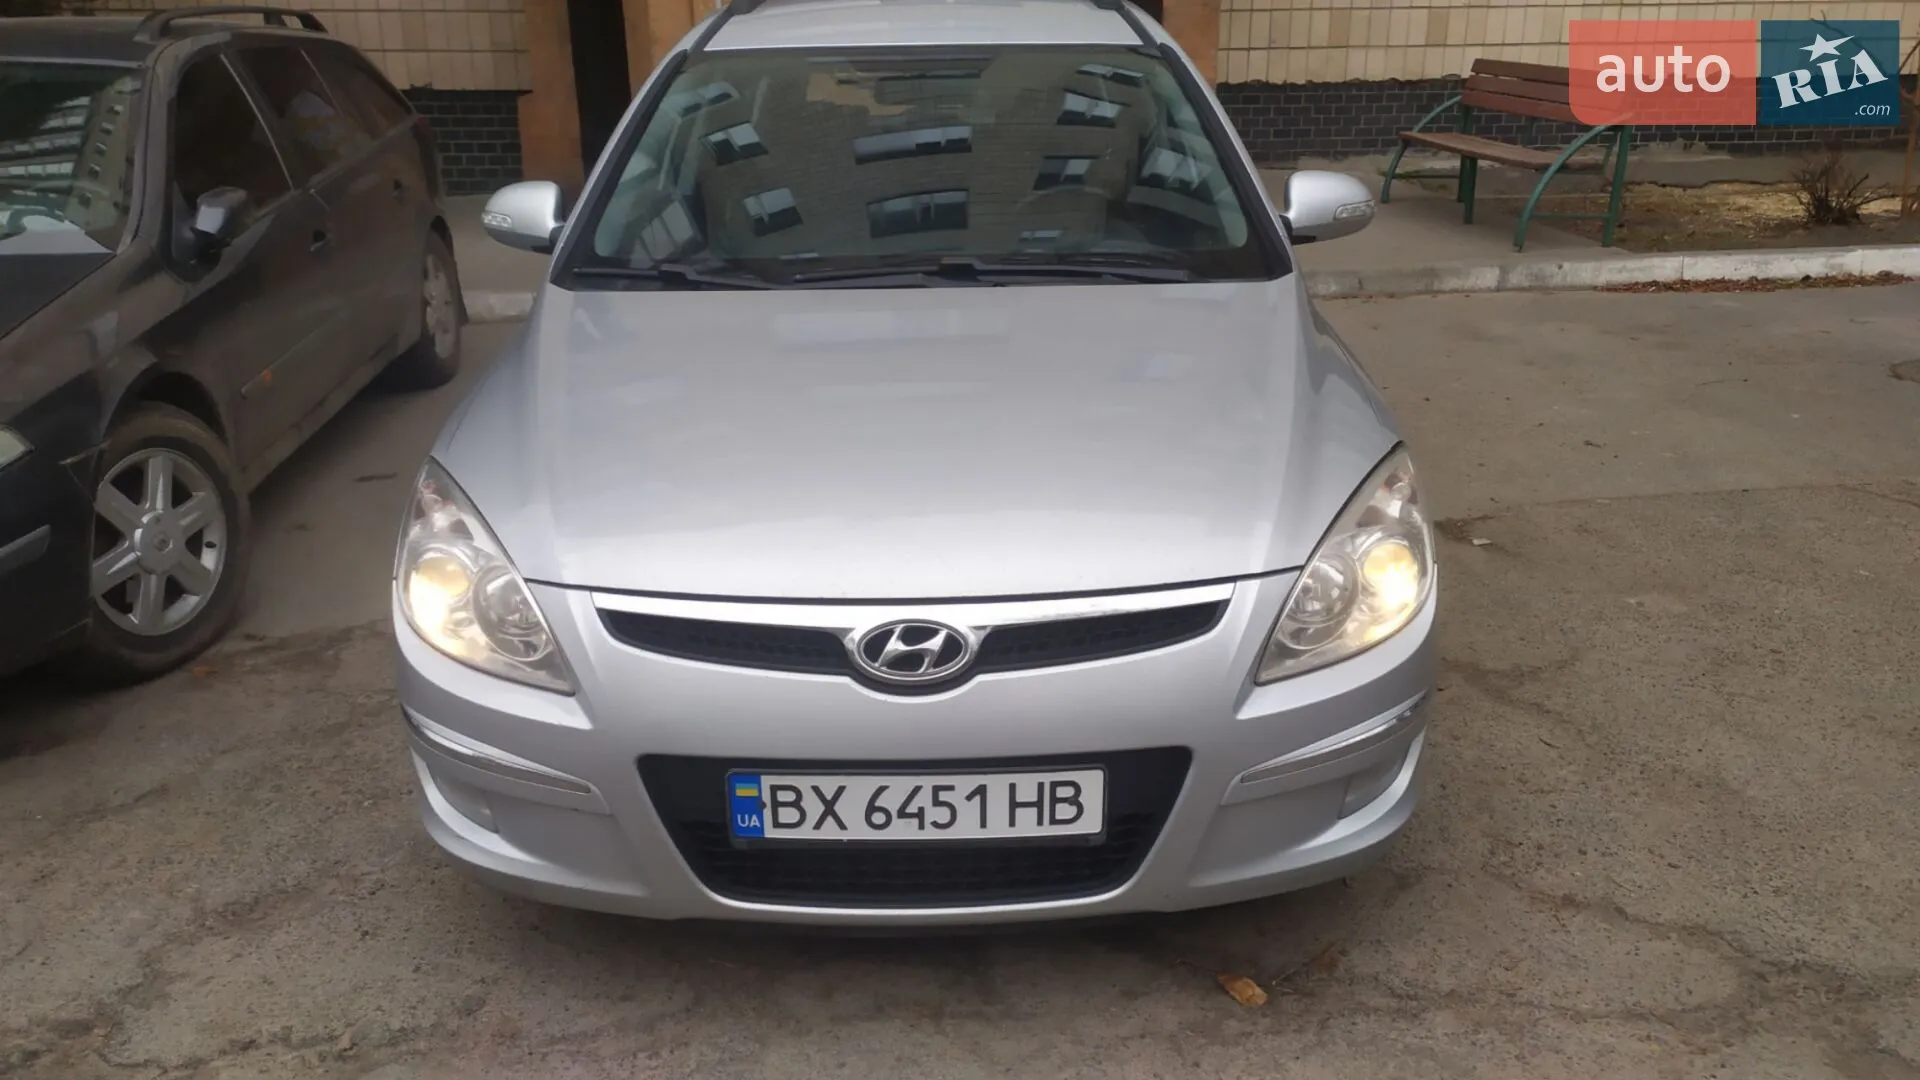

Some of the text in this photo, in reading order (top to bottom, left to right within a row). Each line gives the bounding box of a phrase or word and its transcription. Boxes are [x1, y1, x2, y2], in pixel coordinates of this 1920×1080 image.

[737, 814, 761, 829] UA
[769, 780, 1085, 831] BX 6451 HB
